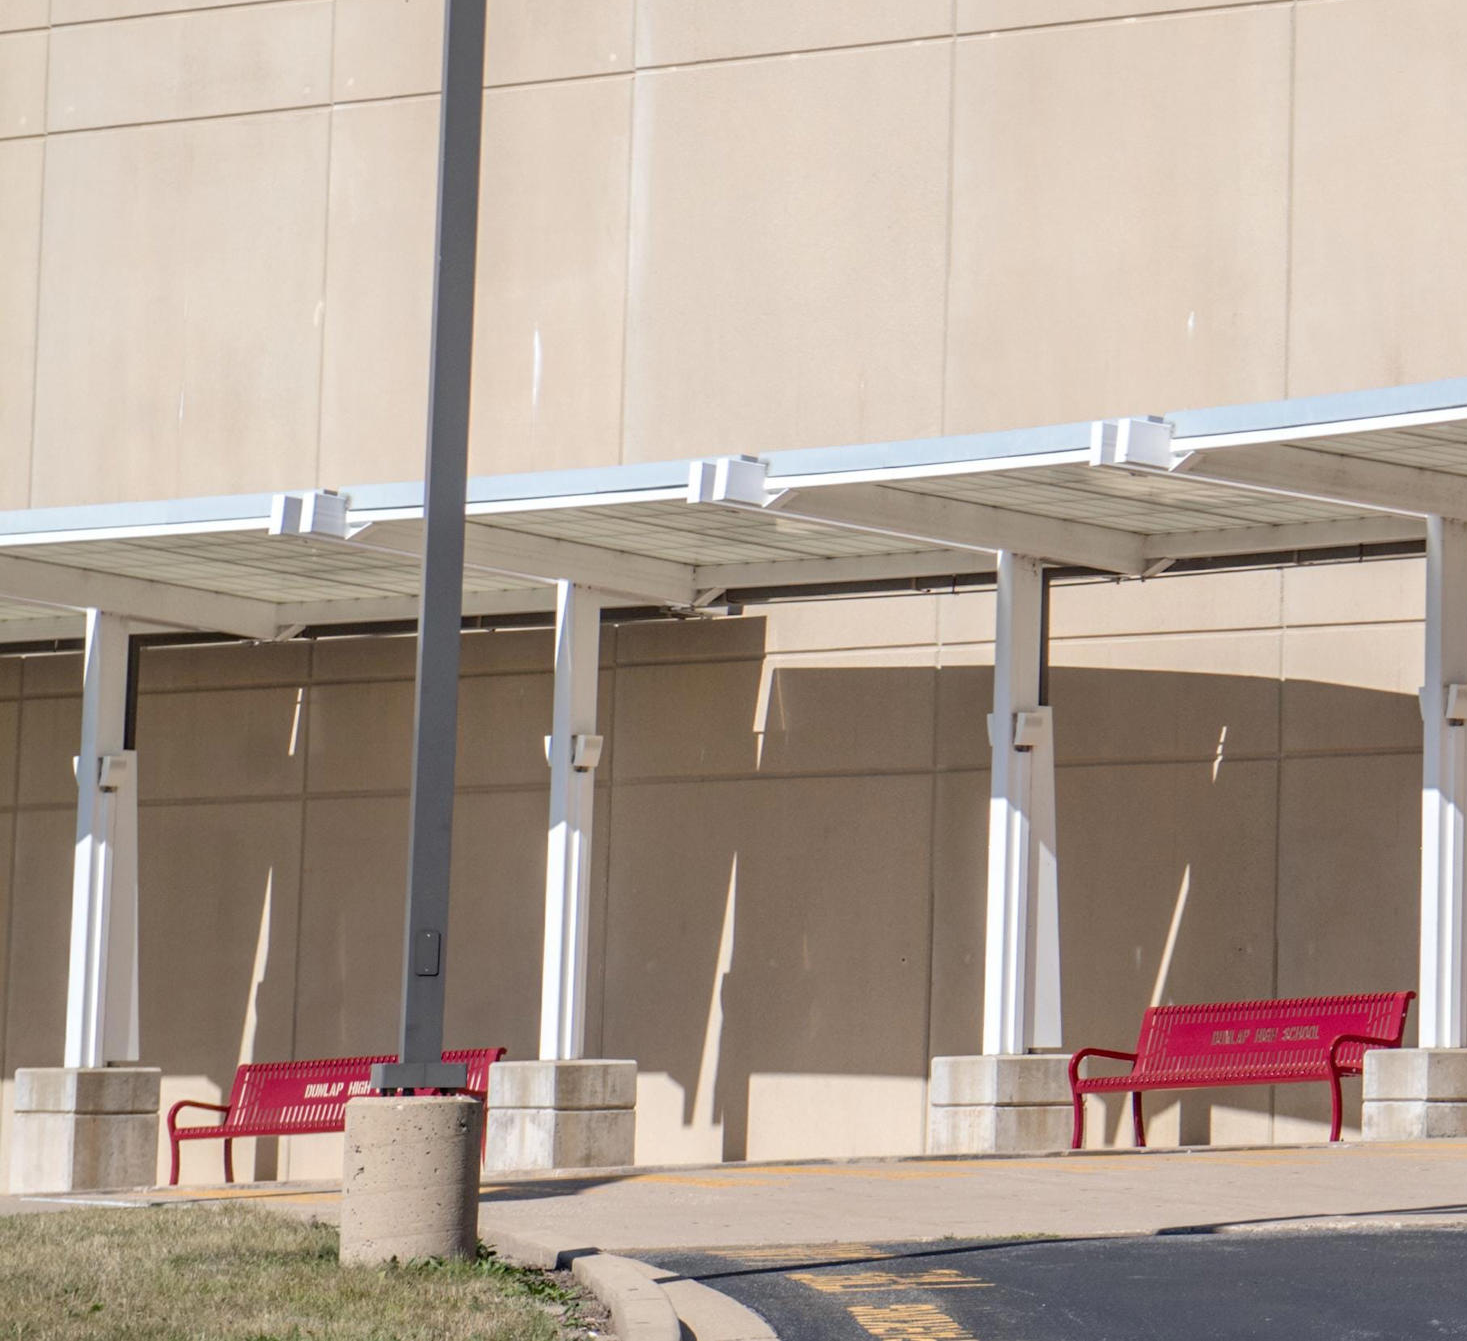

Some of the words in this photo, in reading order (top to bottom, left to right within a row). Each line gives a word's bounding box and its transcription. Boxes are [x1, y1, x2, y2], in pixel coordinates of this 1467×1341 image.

[1212, 1029, 1250, 1045] DUNLAP
[1255, 1027, 1279, 1043] HIGH
[1281, 1025, 1320, 1041] SCHOOL
[304, 1082, 344, 1099] DUNLAP
[347, 1080, 371, 1096] HIGH
